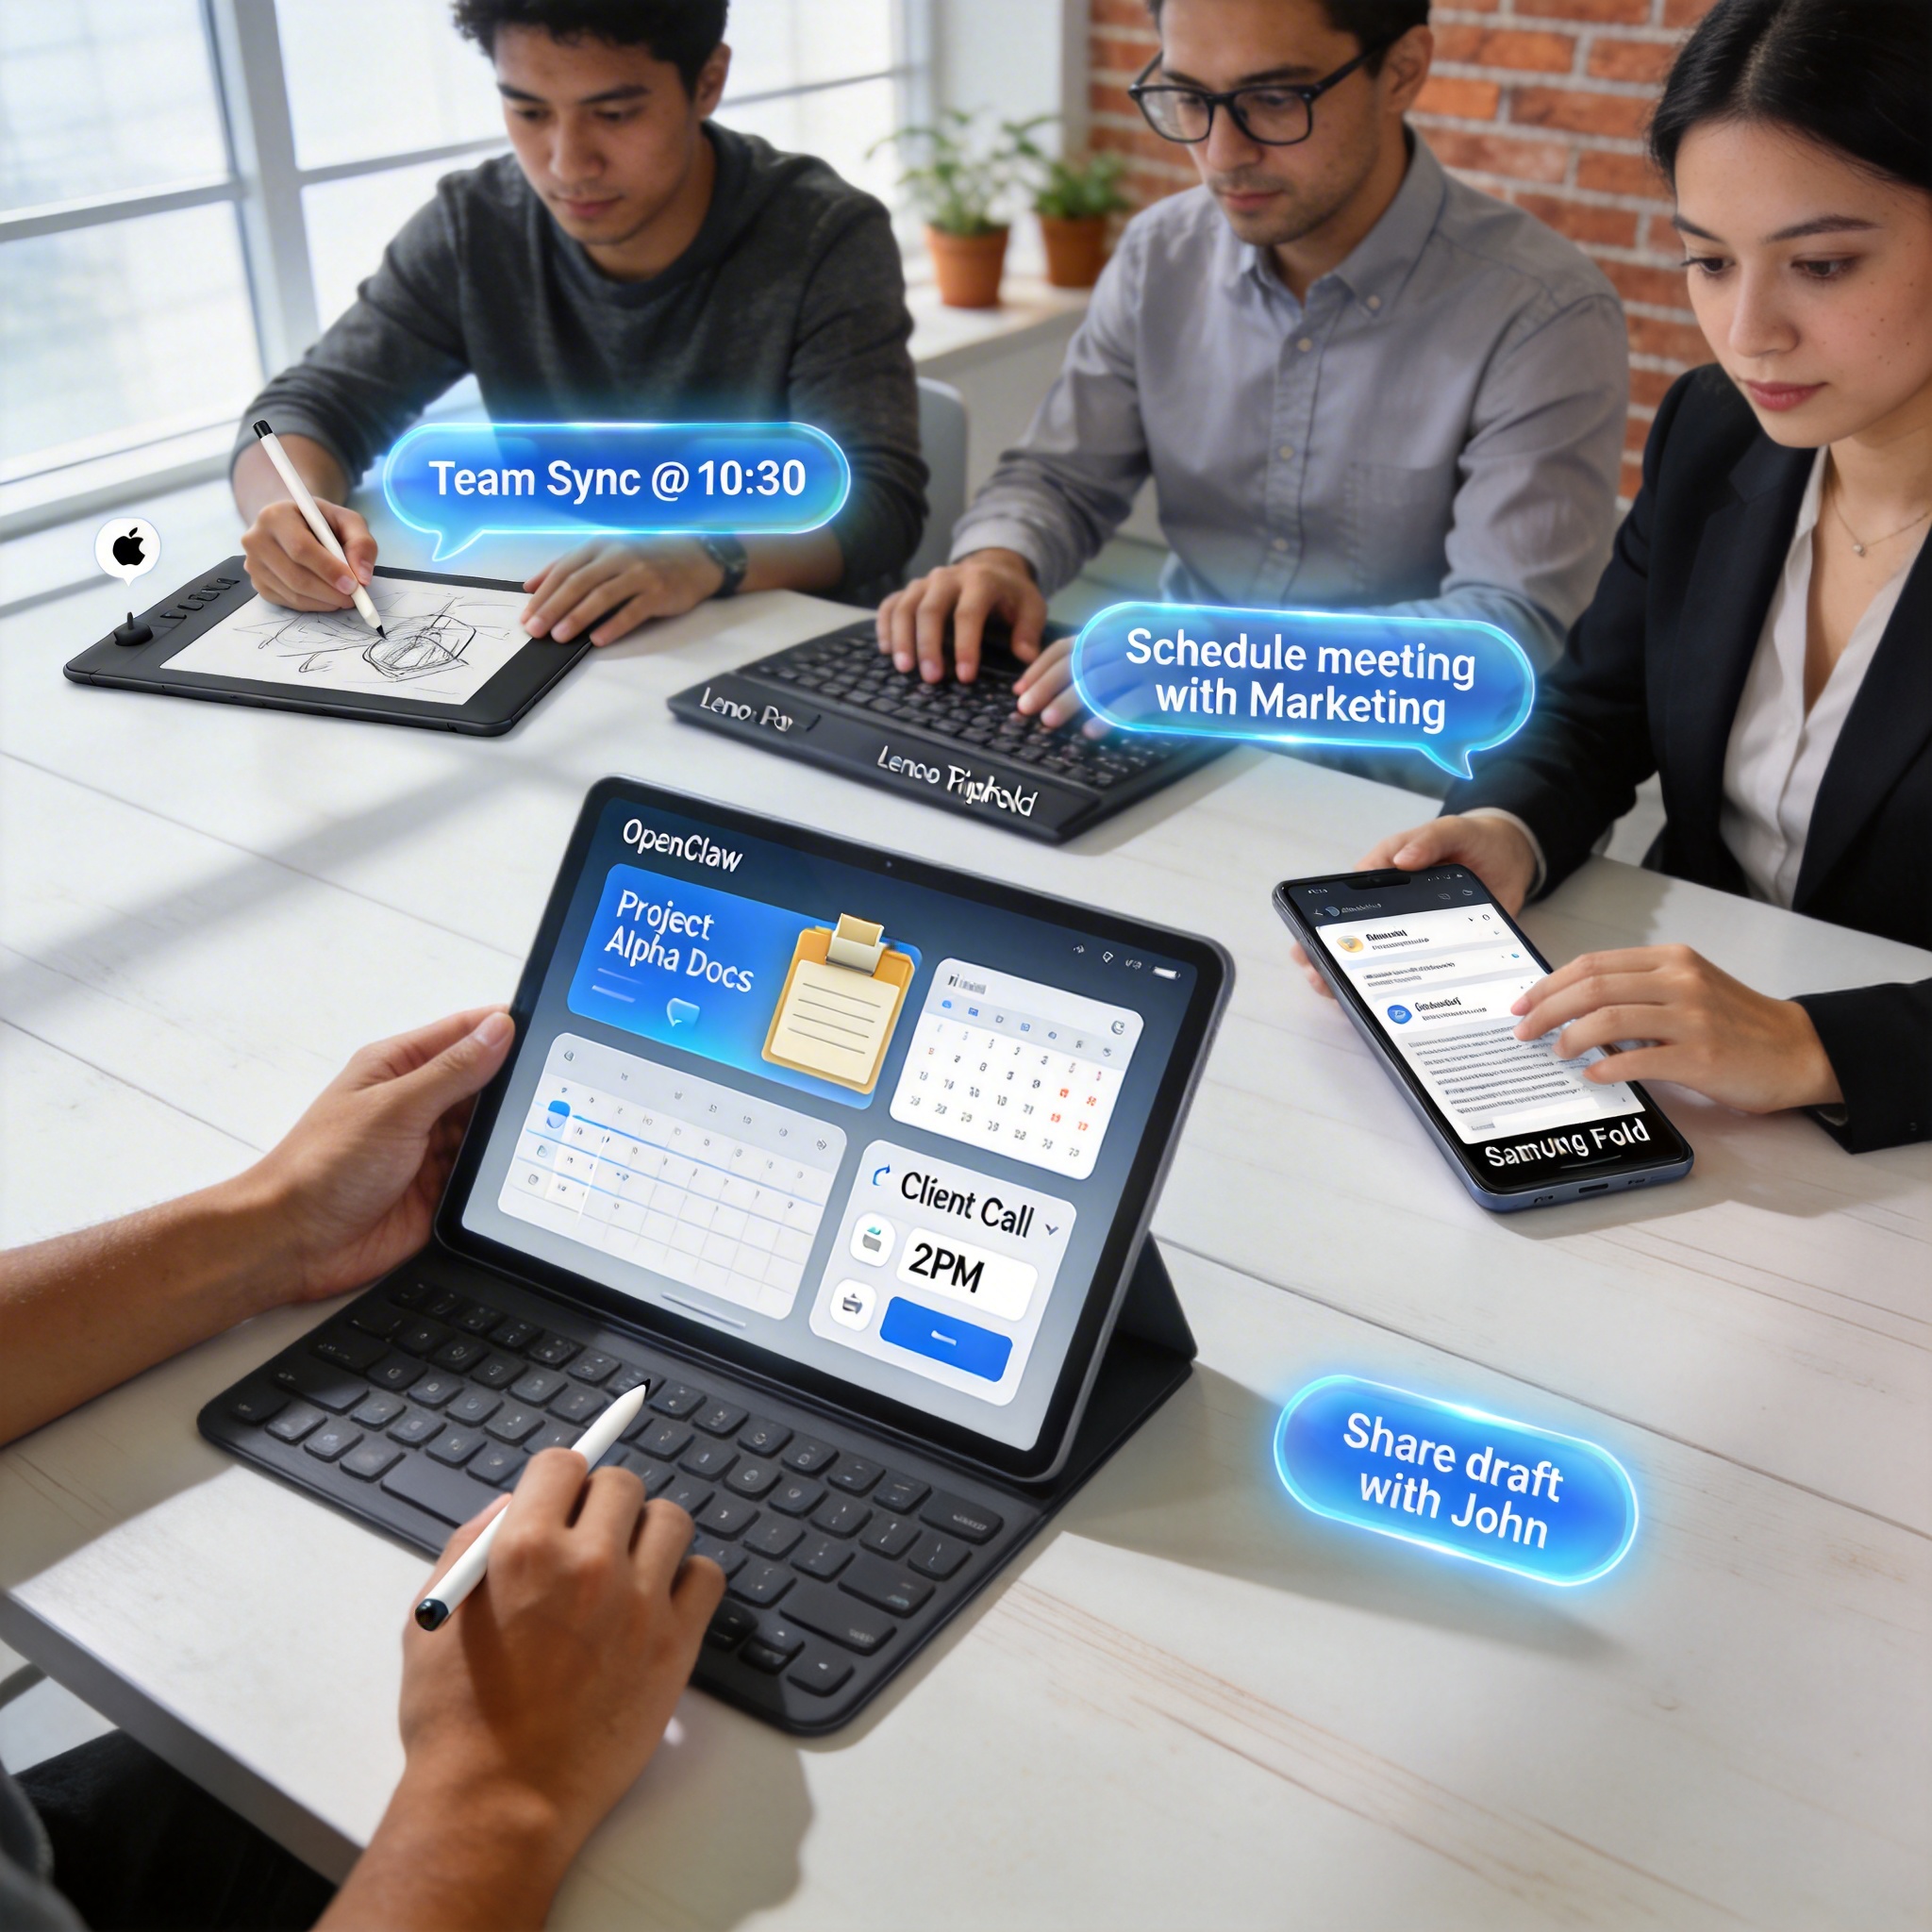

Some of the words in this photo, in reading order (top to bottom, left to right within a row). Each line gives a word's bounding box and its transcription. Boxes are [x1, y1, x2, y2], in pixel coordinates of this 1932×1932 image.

[622, 818, 743, 873] OpenClaw
[616, 890, 714, 941] Project
[605, 925, 680, 974] Alpha
[686, 947, 755, 992] Docs
[1590, 1117, 1651, 1149] Fold
[901, 1172, 975, 1219] Client
[980, 1197, 1035, 1238] Call
[908, 1242, 985, 1293] 2PM
